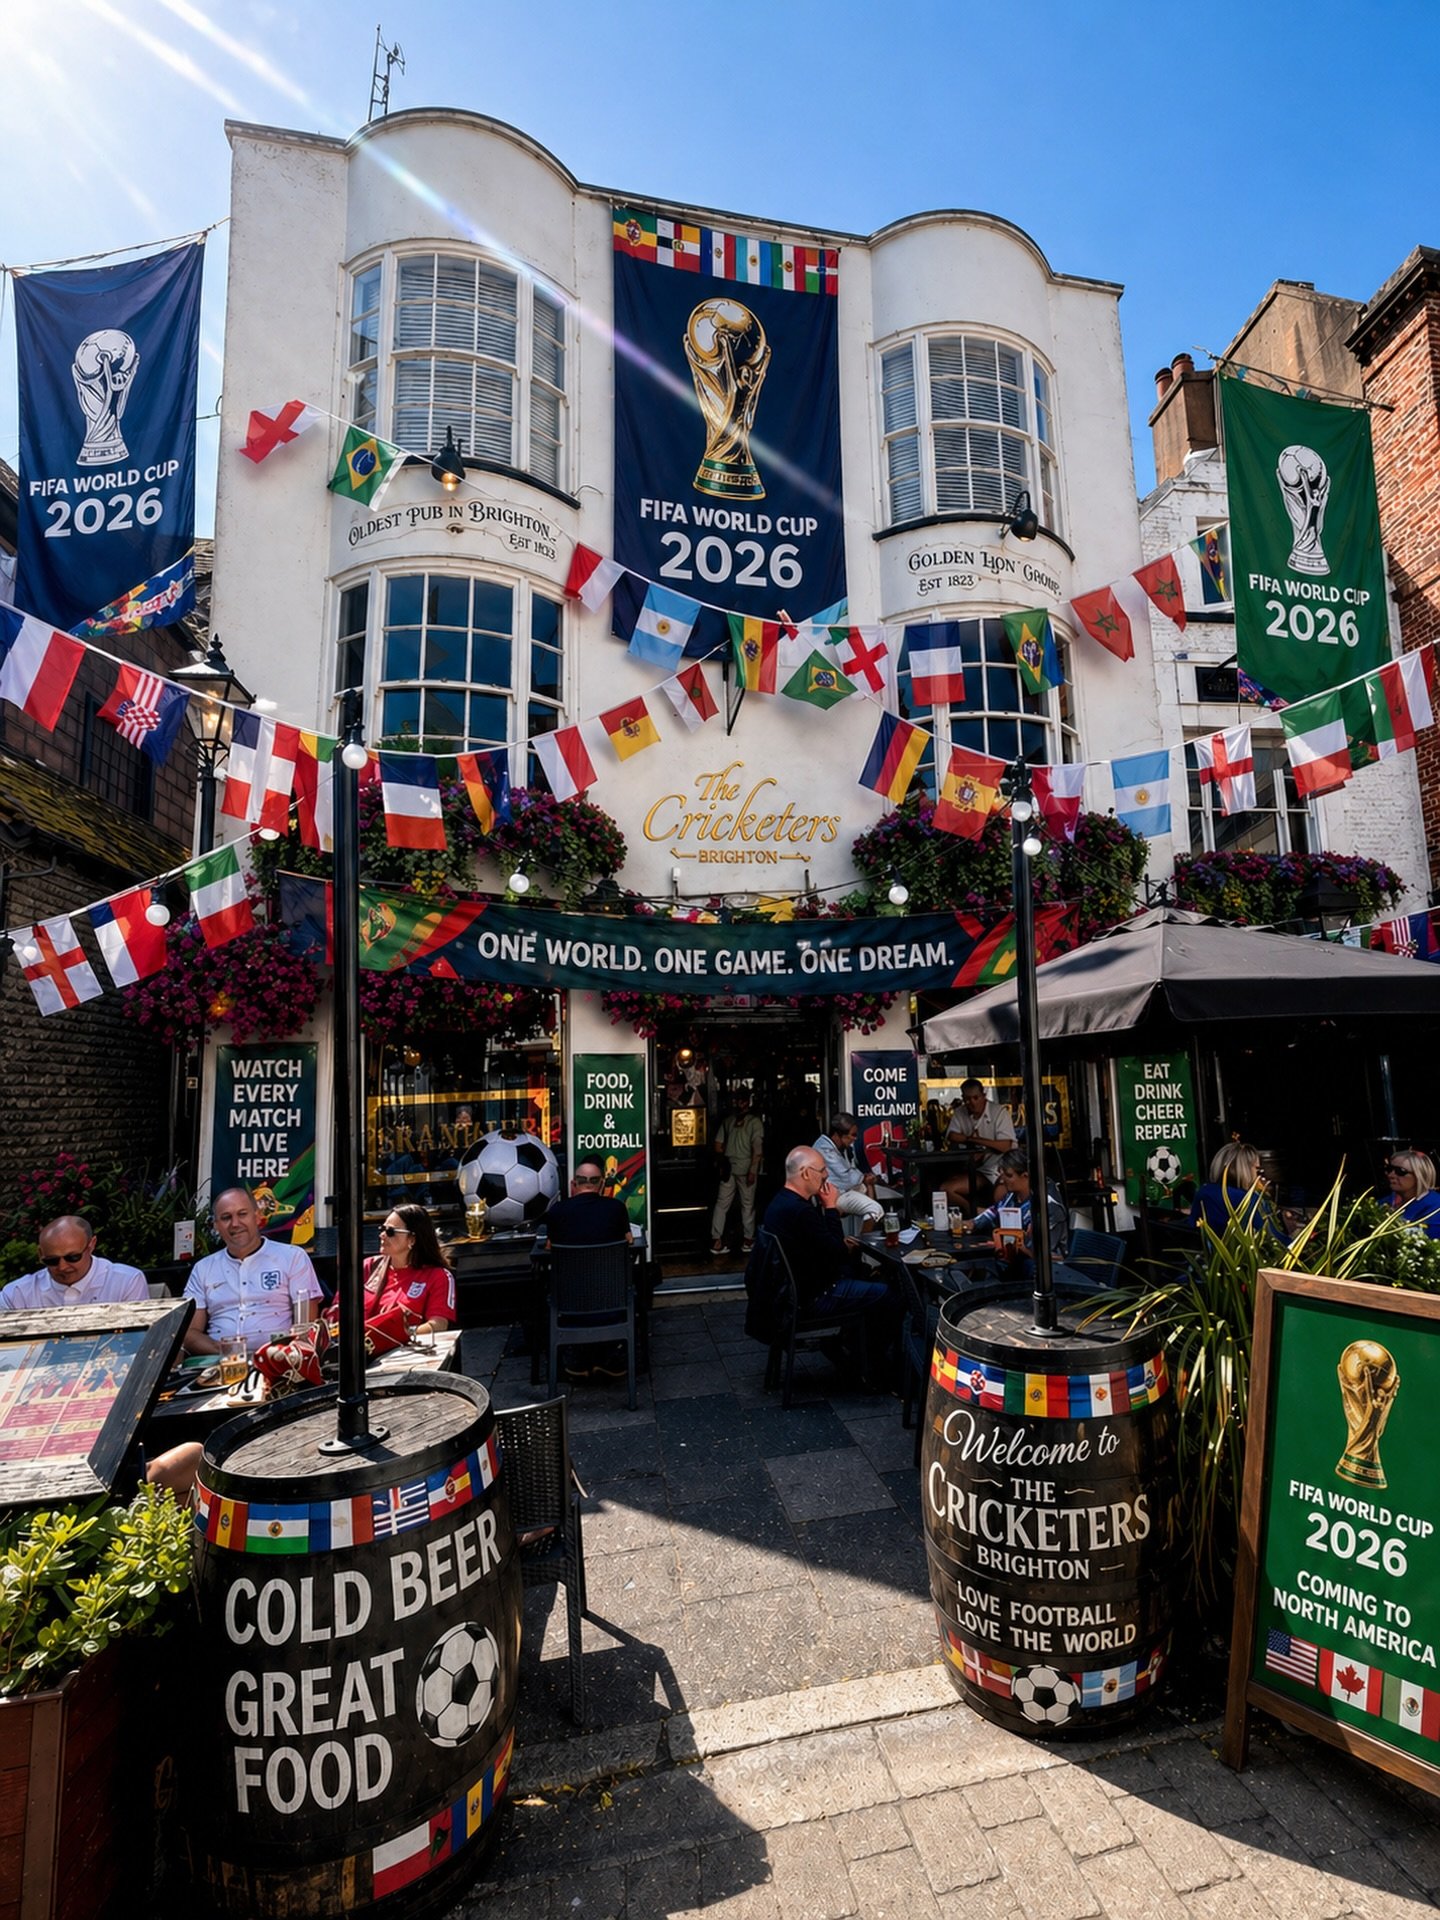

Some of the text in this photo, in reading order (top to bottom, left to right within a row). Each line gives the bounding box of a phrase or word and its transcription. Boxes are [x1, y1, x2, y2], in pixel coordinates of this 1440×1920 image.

[29, 459, 179, 497] FIFA WORLD CUP
[44, 487, 163, 538] 2026
[348, 513, 402, 546] OLDEST
[406, 505, 443, 526] PUB
[449, 506, 463, 518] IN
[640, 498, 818, 536] FIFA WORLD CUP
[659, 531, 803, 589] 2026
[908, 550, 974, 571] GOLDEN
[917, 575, 975, 596] EST 1823
[1248, 573, 1370, 606] FIFA WORLD CUP
[1265, 600, 1360, 647] 2026
[694, 760, 744, 801] The
[643, 777, 841, 843] Cricketers
[698, 849, 778, 864] BRIGHTON
[478, 931, 955, 975] ONE WORLD. ONE GAME. ONE DREAM.
[231, 1059, 302, 1078] WATCH
[587, 1073, 633, 1091] FOOD,
[863, 1067, 907, 1083] COME
[1143, 1063, 1171, 1079] EAT
[233, 1084, 299, 1103] EVERY
[584, 1093, 634, 1109] DRINK
[875, 1086, 897, 1100] ON
[1134, 1083, 1184, 1100] DRINK
[229, 1108, 301, 1128] MATCH
[603, 1113, 615, 1129] &
[857, 1103, 917, 1116] ENGLAND!
[1135, 1103, 1184, 1120] CHEER
[240, 1133, 288, 1153] LIVE
[577, 1133, 643, 1149] FOOTBALL
[1135, 1123, 1187, 1141] REPEAT
[237, 1158, 290, 1178] HERE
[943, 1409, 1120, 1467] Welcome to
[928, 1461, 1151, 1553] CRICKETERS
[1010, 1477, 1056, 1504] THE
[1289, 1479, 1434, 1539] FIFA WORLD CUP
[1305, 1512, 1407, 1577] 2026
[225, 1508, 503, 1646] COLD BEER
[977, 1544, 1090, 1580] BRIGHTON
[957, 1580, 1116, 1627] LOVE FOOTBALL
[1297, 1570, 1411, 1628] COMING TO
[955, 1604, 1136, 1654] LOVE THE WORLD
[1273, 1587, 1437, 1668] NORTH AMERICA
[225, 1647, 405, 1737] GREAT
[234, 1733, 393, 1815] FOOD
